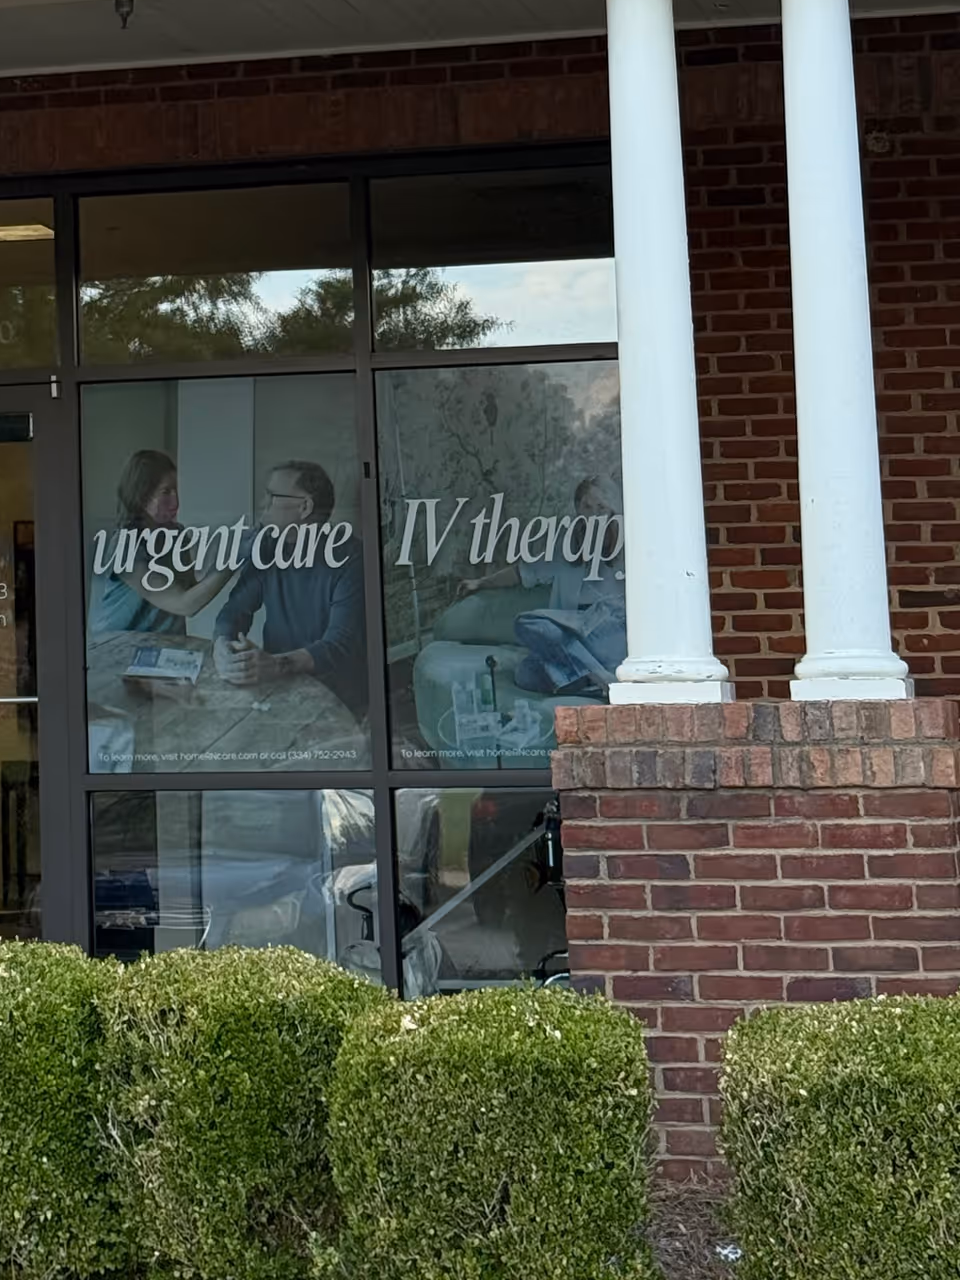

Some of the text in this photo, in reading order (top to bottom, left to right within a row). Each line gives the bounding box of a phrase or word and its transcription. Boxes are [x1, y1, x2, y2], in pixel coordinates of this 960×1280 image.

[92, 514, 353, 592] urgent care
[395, 492, 624, 582] IV therap
[98, 751, 110, 761] To
[111, 751, 133, 761] learn
[161, 751, 178, 760] visit
[260, 752, 269, 760] or
[270, 751, 286, 760] call
[288, 750, 312, 760] (334)
[401, 749, 413, 758] To
[414, 749, 437, 758] learn
[467, 748, 484, 757] visit
